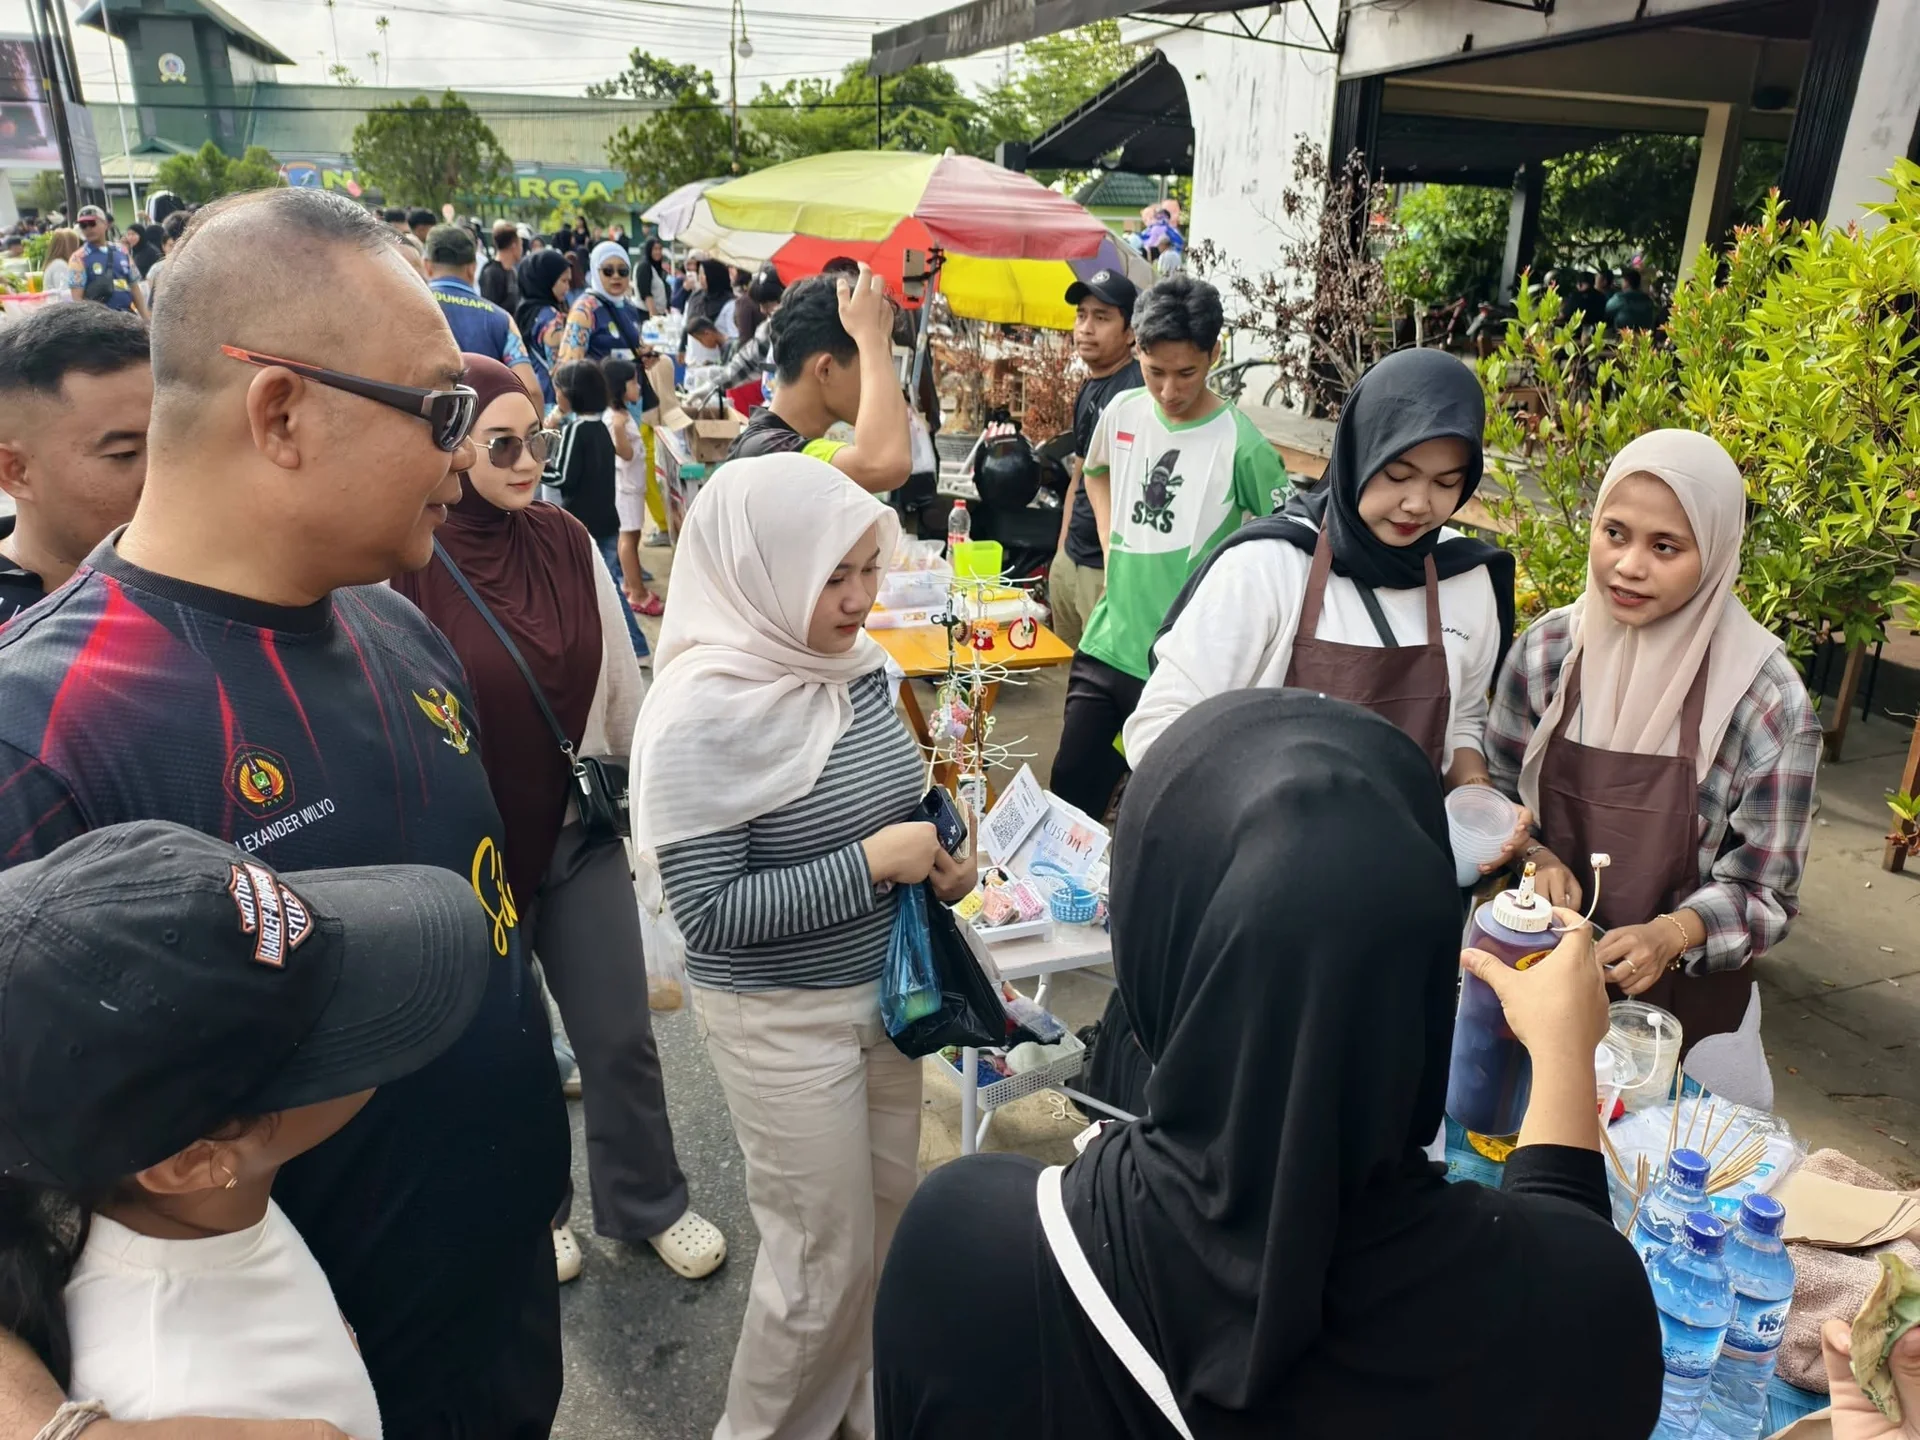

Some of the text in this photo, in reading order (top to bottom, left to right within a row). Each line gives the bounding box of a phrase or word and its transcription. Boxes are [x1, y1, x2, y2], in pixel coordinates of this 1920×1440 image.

[234, 798, 336, 854] LEXANDER WILYO
[234, 872, 256, 925] MOTOR
